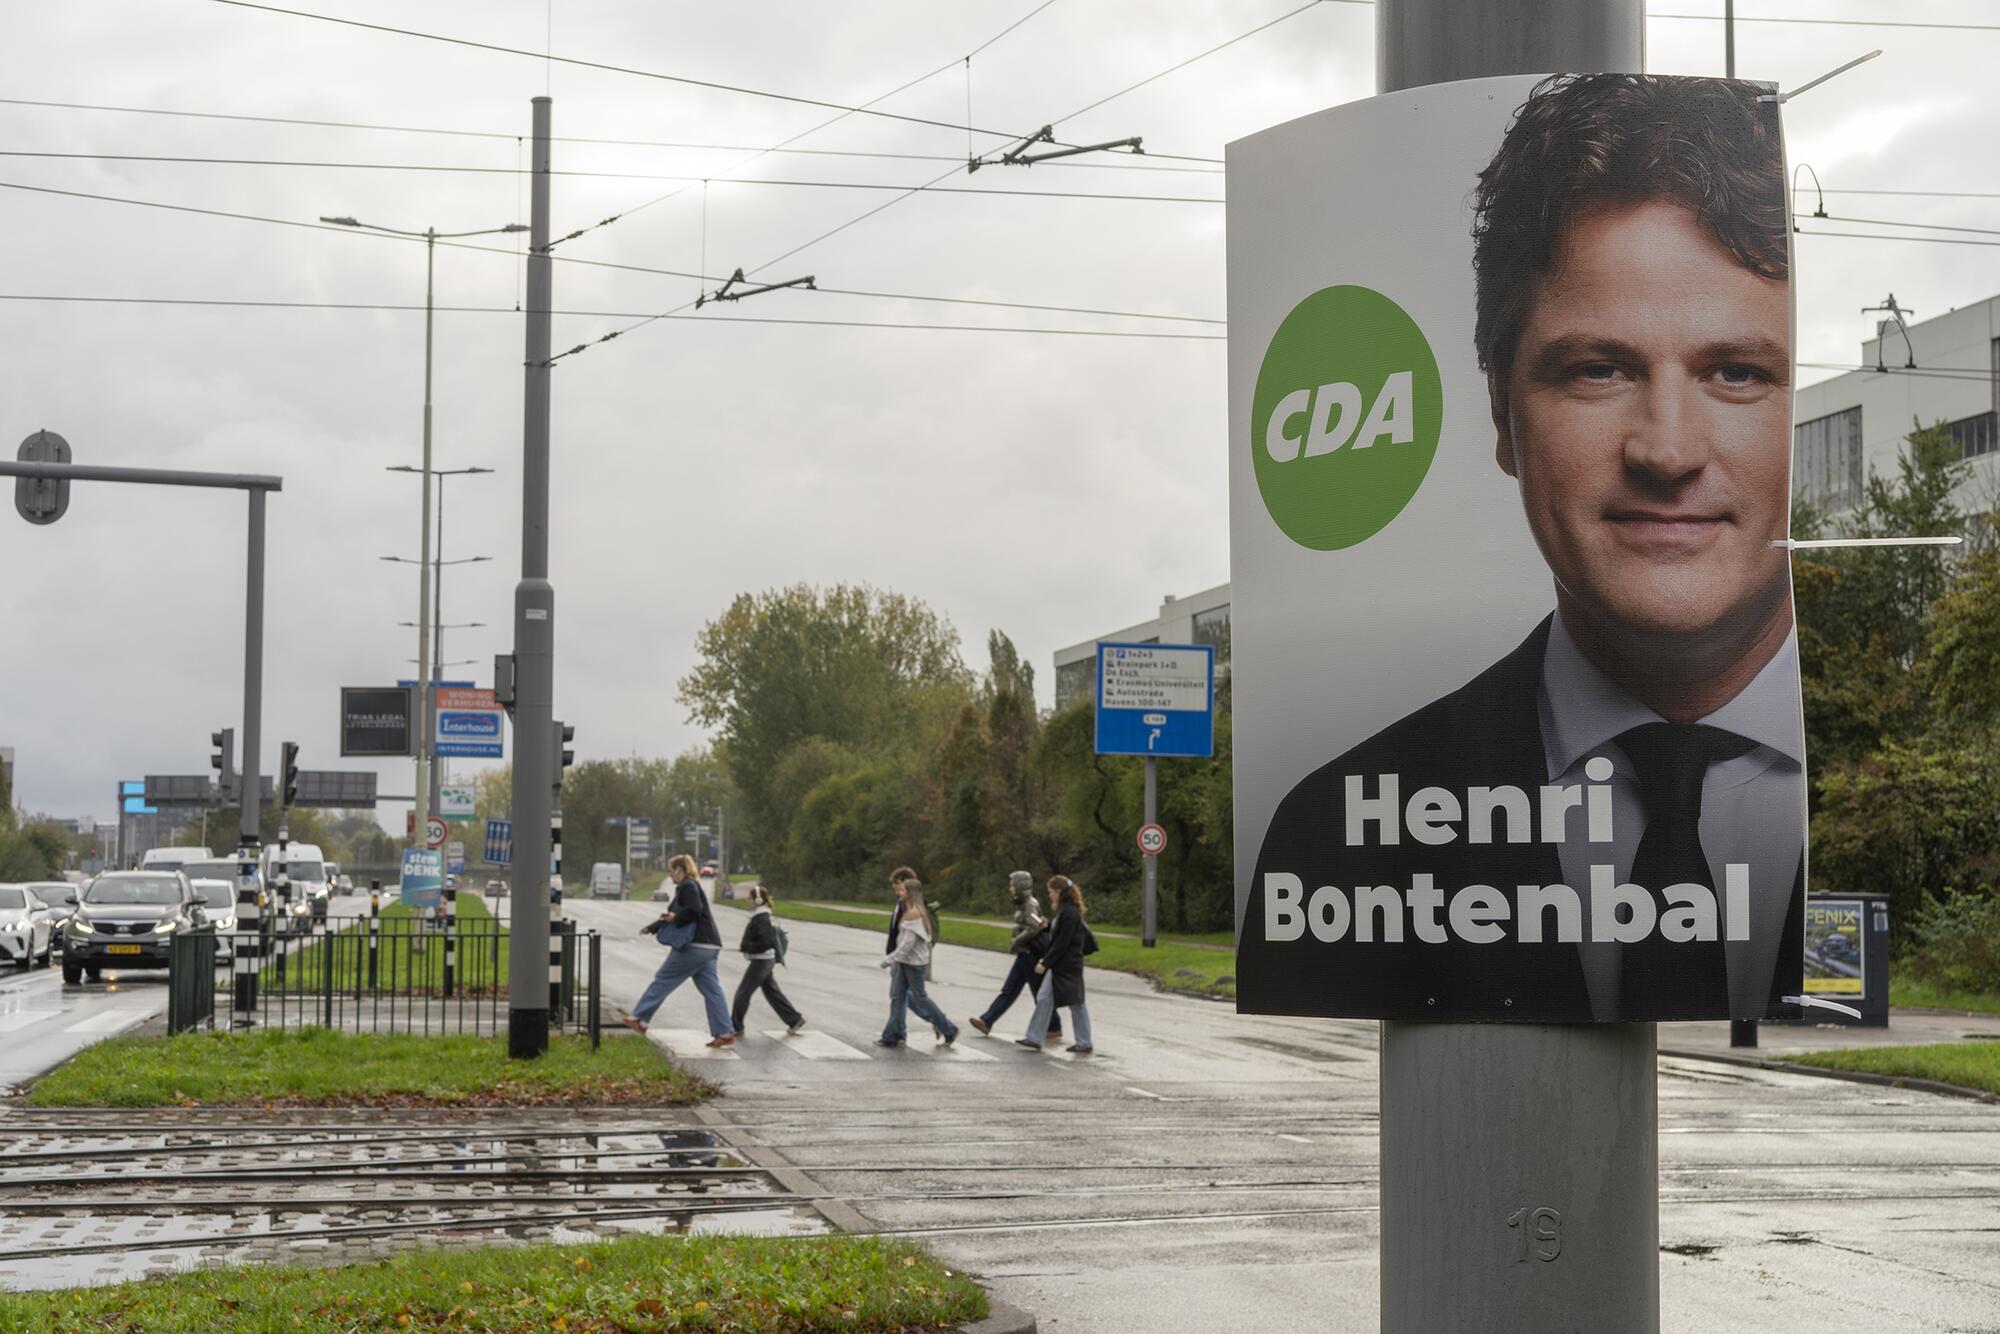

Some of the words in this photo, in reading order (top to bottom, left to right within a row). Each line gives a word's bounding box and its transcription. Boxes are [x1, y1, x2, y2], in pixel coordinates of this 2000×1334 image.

[1265, 370, 1414, 463] CDA
[1154, 680, 1204, 688] Universiteit
[1116, 689, 1164, 697] Autostrada
[443, 718, 496, 733] Interhouse
[1345, 757, 1614, 846] Henri
[1144, 833, 1161, 845] 50
[409, 853, 438, 865] stem
[404, 865, 441, 877] DENK
[1264, 863, 1750, 944] Bontenbal
[1807, 908, 1856, 925] FENIX
[1507, 1206, 1562, 1263] 19
